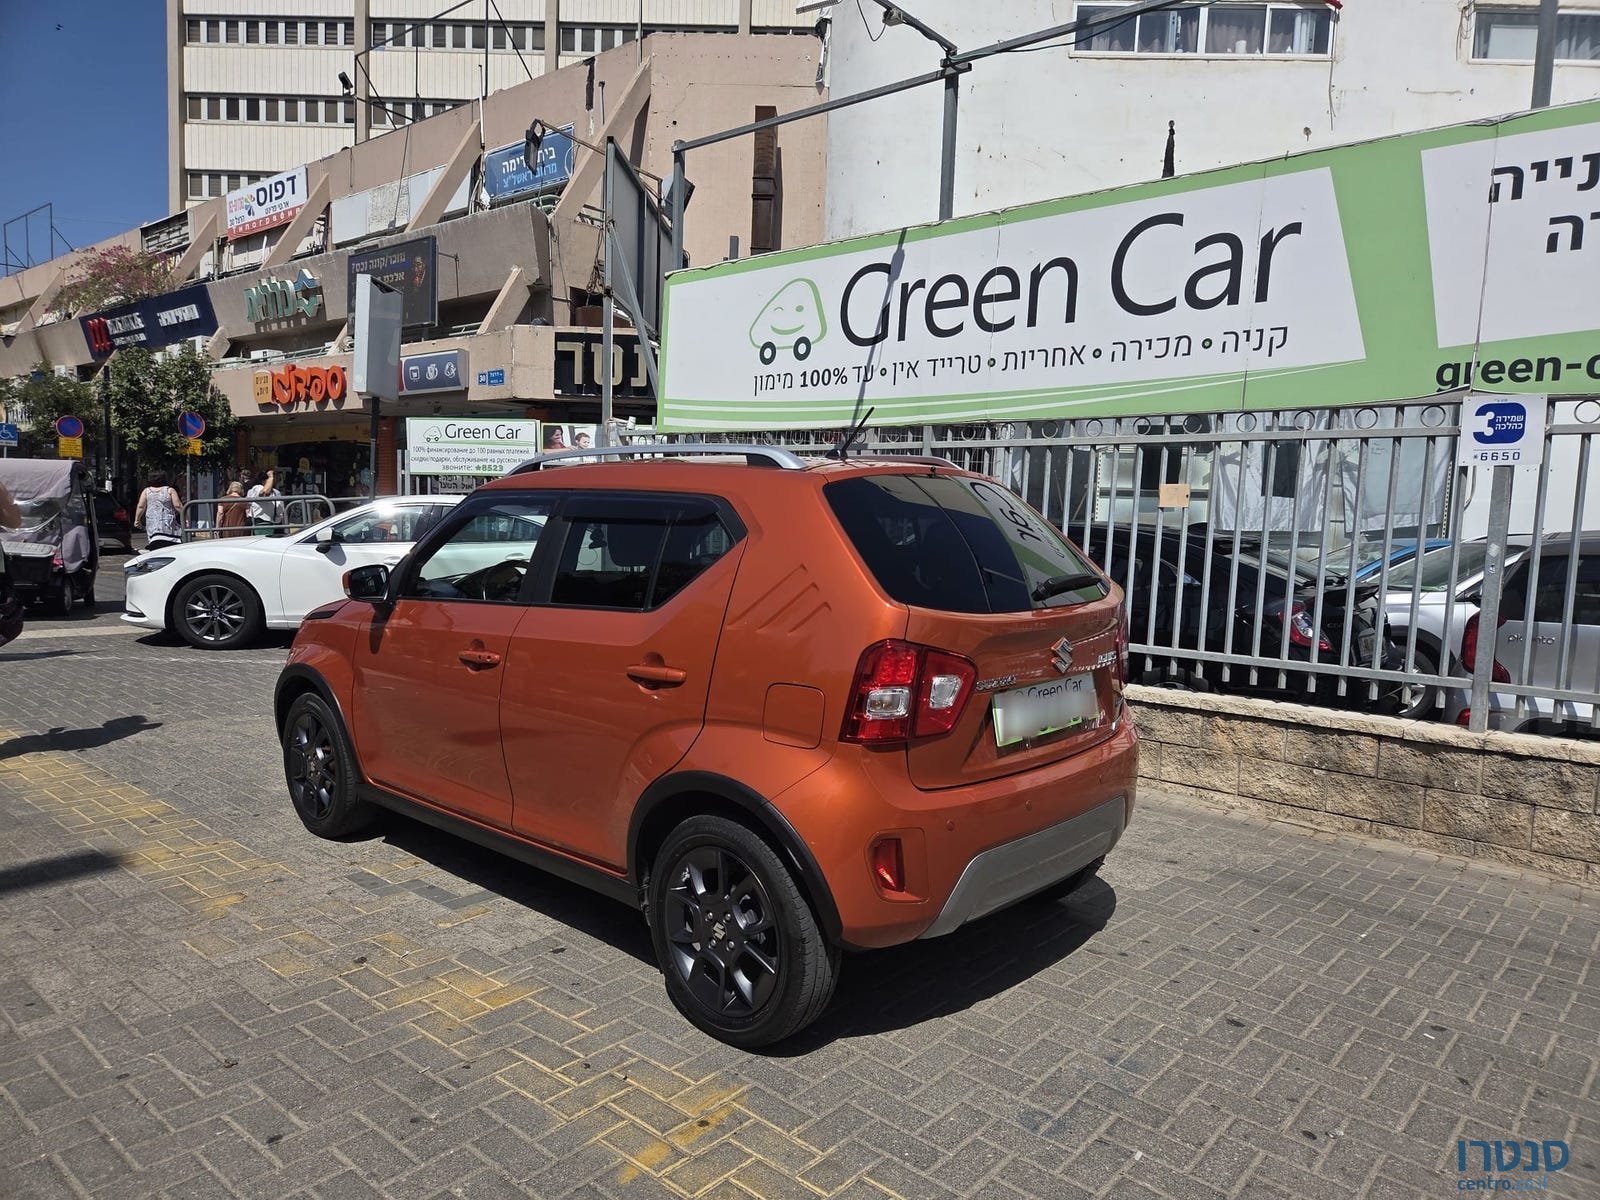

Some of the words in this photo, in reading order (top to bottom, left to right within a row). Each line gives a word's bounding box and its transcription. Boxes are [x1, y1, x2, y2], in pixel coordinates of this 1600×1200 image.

[537, 147, 556, 163] בית
[256, 175, 297, 207] דפוס
[840, 256, 1080, 347] Green
[1111, 212, 1302, 316] Car
[1111, 334, 1192, 363] מכירה
[1221, 324, 1288, 357] קניה
[926, 354, 982, 376] טרייד
[1001, 344, 1086, 371] אחריות
[753, 370, 794, 397] מימון
[798, 366, 848, 387] 100%
[852, 363, 877, 384] עד
[891, 361, 920, 386] אין
[1495, 422, 1523, 430] כהלכה
[1496, 415, 1524, 423] שמירה
[444, 423, 491, 439] Green
[494, 424, 522, 440] Car
